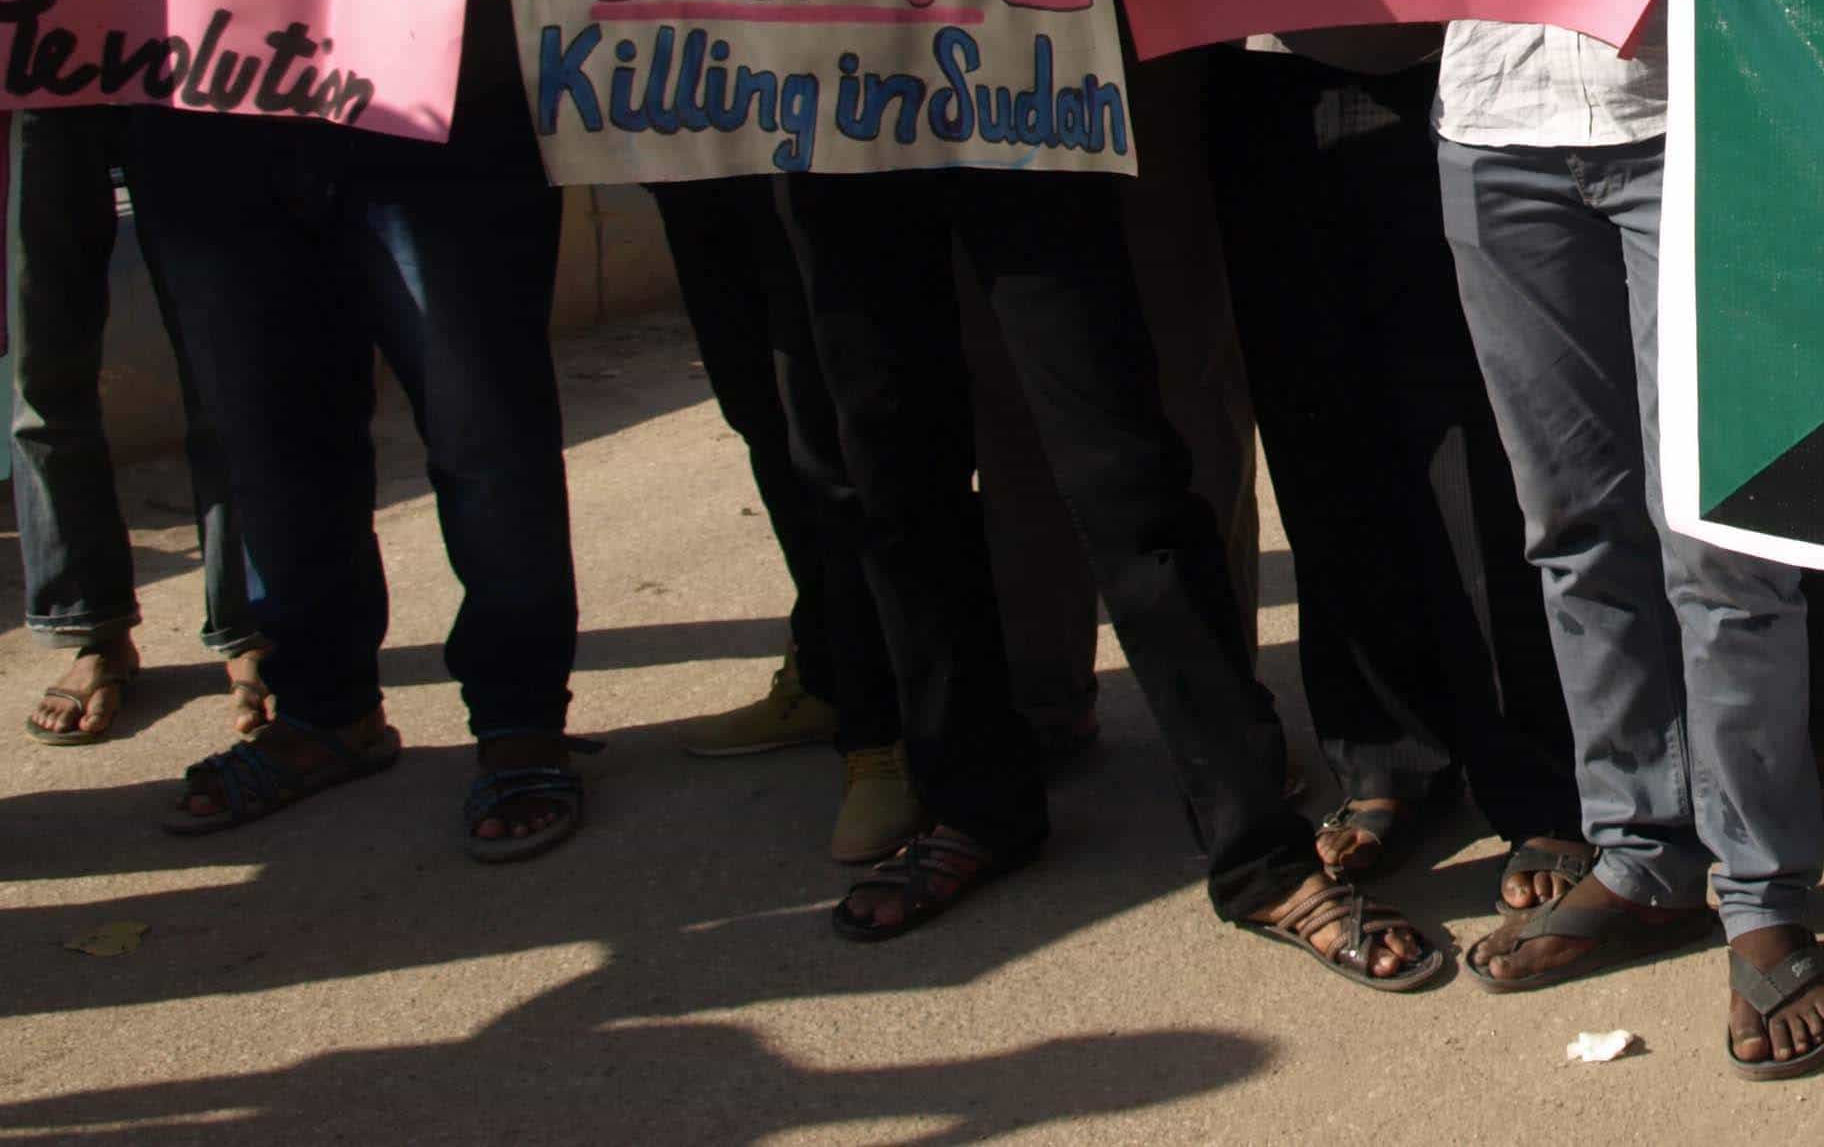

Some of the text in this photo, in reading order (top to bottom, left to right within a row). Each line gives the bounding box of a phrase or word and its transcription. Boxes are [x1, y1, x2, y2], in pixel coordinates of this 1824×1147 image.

[537, 23, 1128, 174] Killing in Sudan
